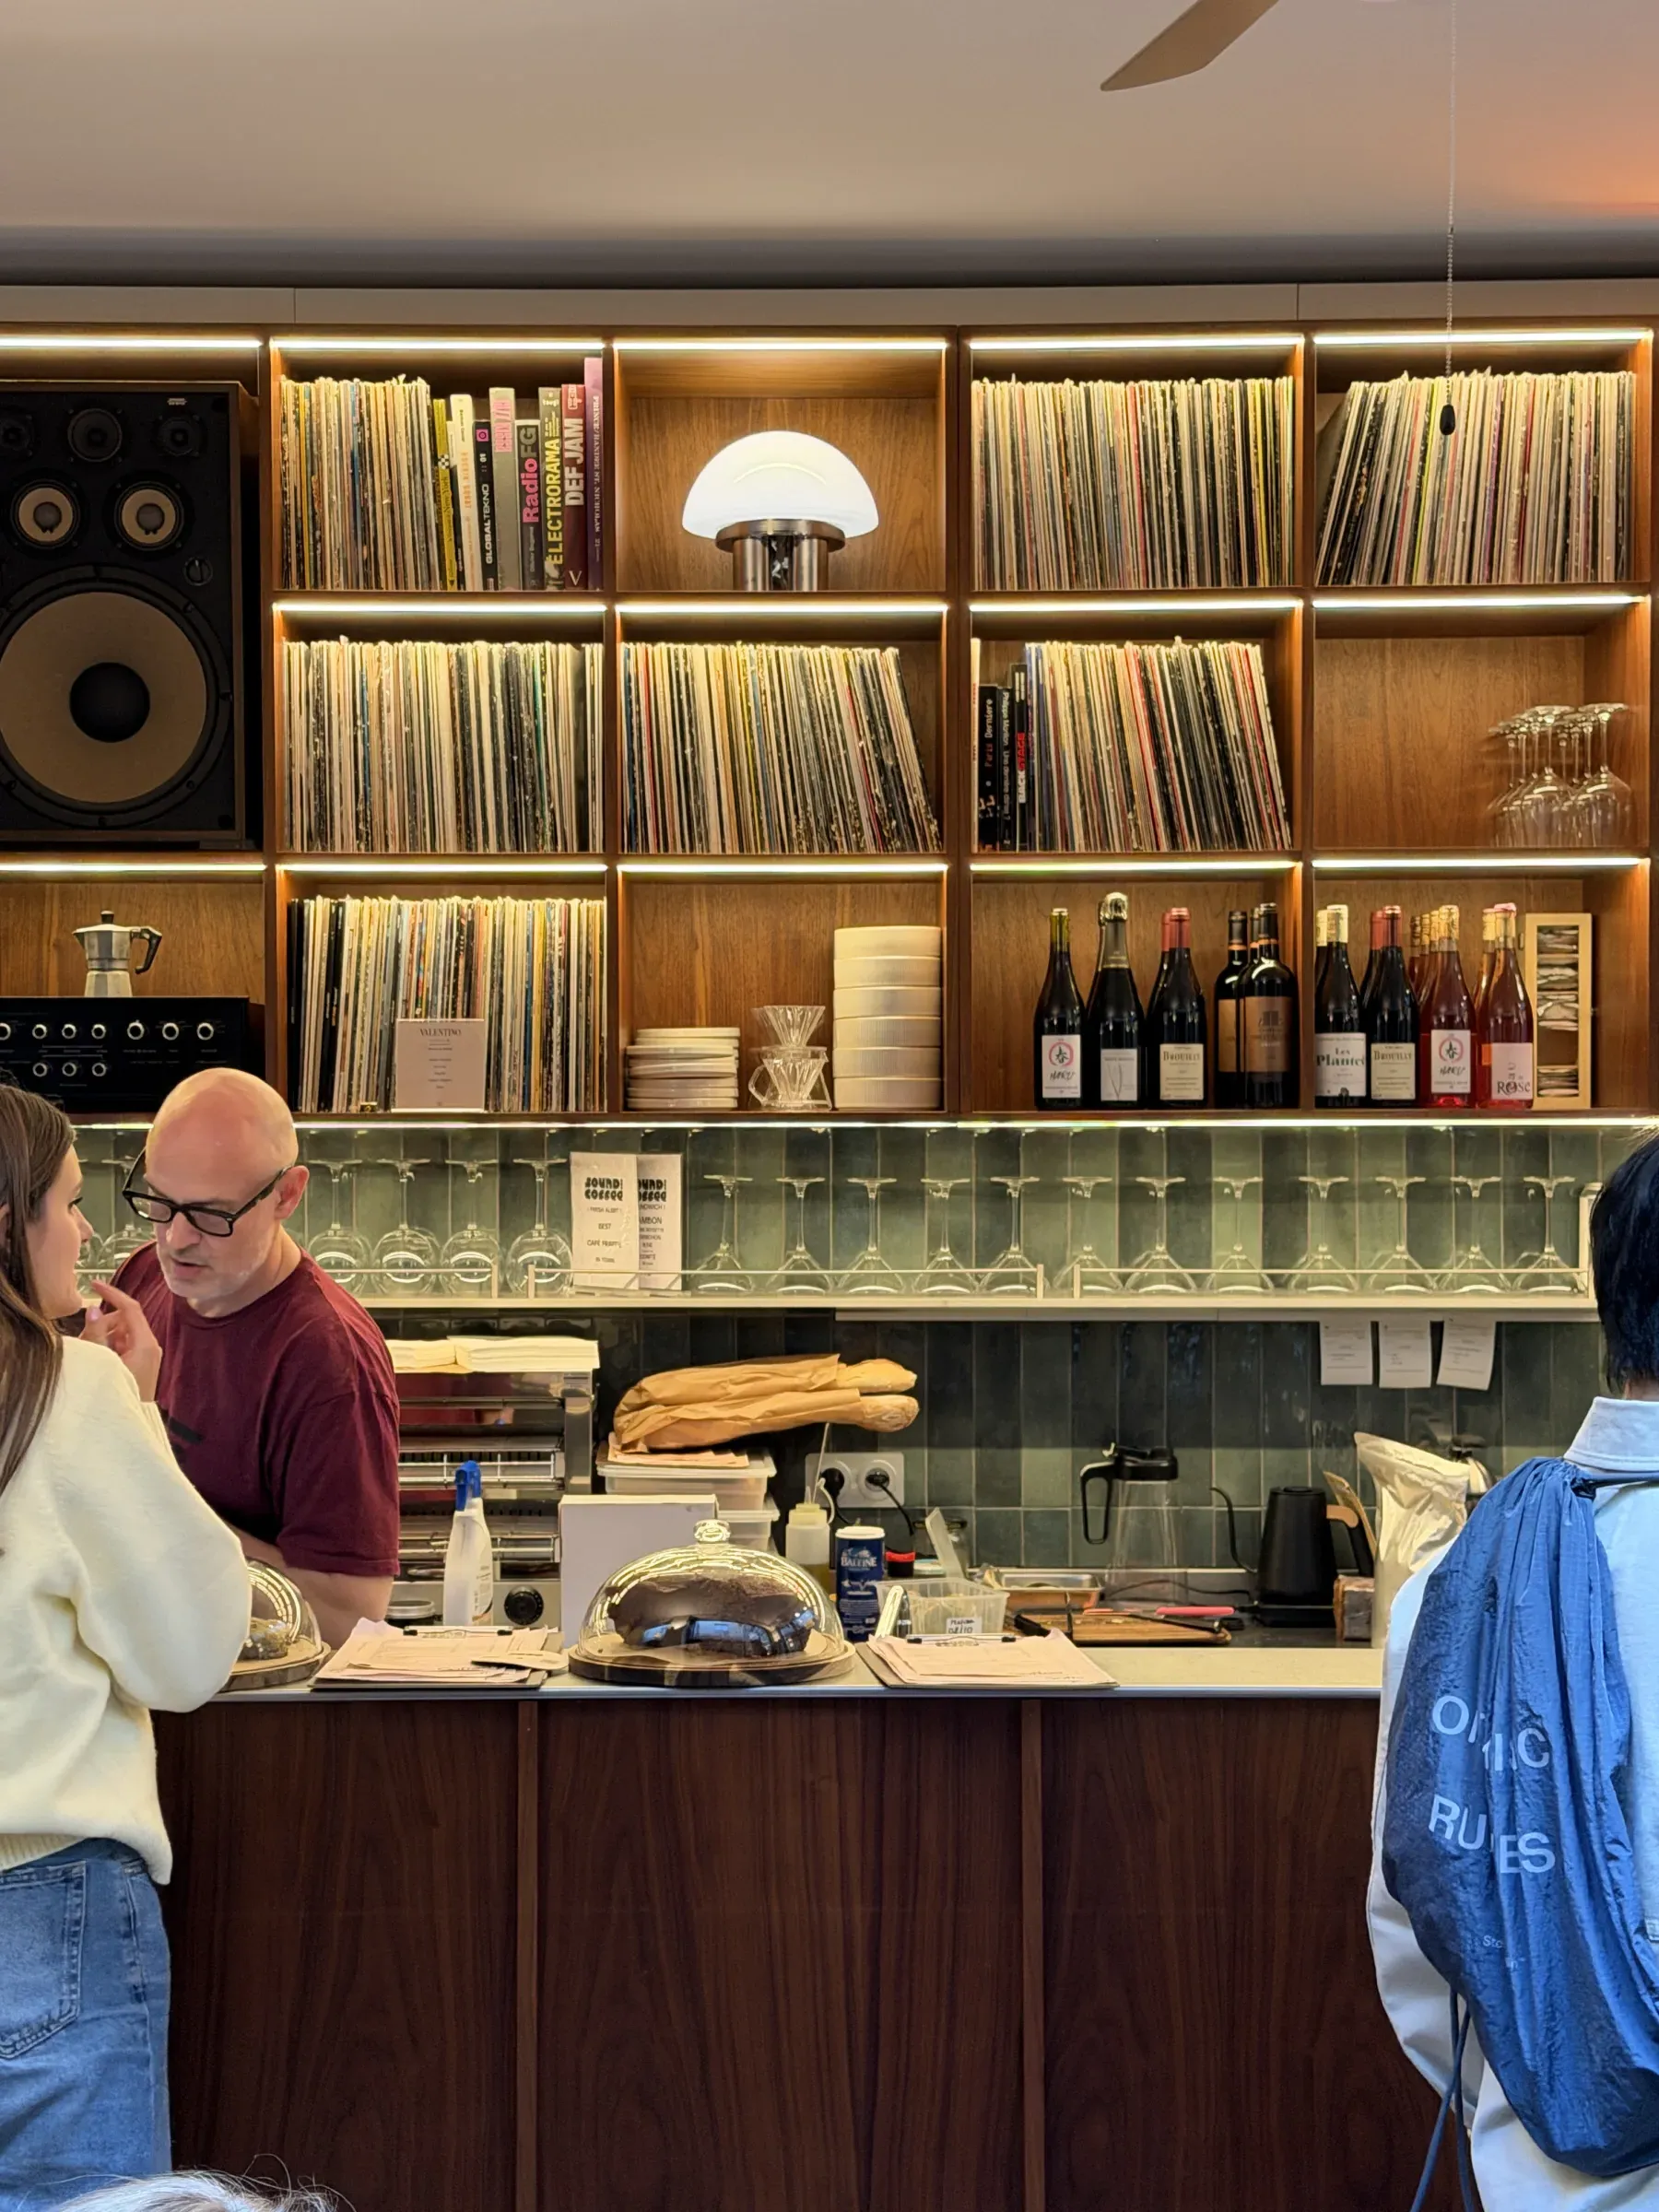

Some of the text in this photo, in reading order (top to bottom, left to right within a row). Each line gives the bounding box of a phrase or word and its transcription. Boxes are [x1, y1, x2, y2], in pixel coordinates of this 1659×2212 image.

[565, 418, 583, 506] DEF JAM
[545, 440, 563, 565] ÉLECTRORAMA
[481, 484, 494, 564] GLOBALTEKNO
[1017, 732, 1026, 804] BACKSTAGE
[1163, 1051, 1200, 1061] BROUILLY
[1373, 1051, 1412, 1061] BROUILLY
[584, 1177, 620, 1189] SOUND
[584, 1189, 623, 1201] COFFEE
[841, 1557, 877, 1568] BALEINE
[1429, 1794, 1556, 1874] RUES
